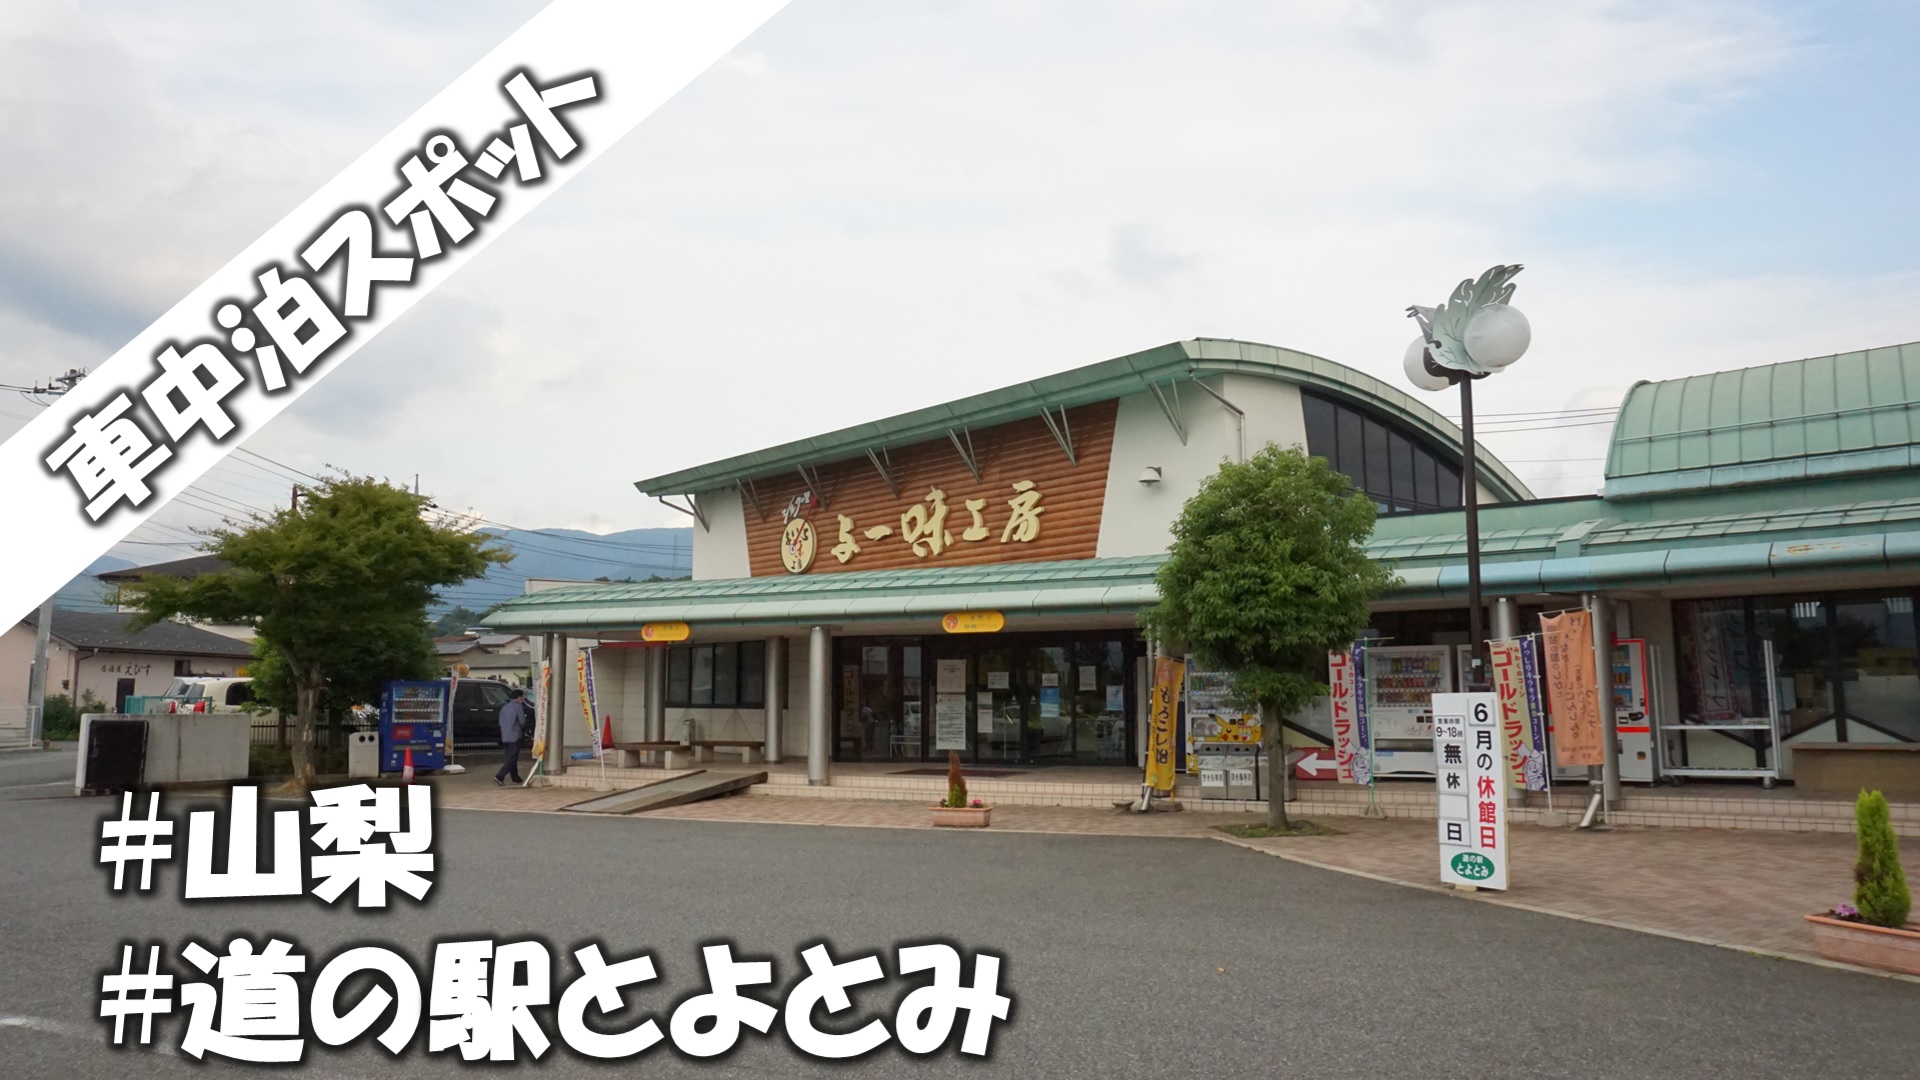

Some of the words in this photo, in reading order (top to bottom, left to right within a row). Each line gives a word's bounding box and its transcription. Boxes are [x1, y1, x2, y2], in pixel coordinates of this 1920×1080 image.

[1493, 646, 1528, 784] ゴールドラッシュ
[1473, 702, 1497, 850] 6月の休館日
[1455, 862, 1490, 879] とよとみ
[1461, 853, 1484, 865] 道の駅
